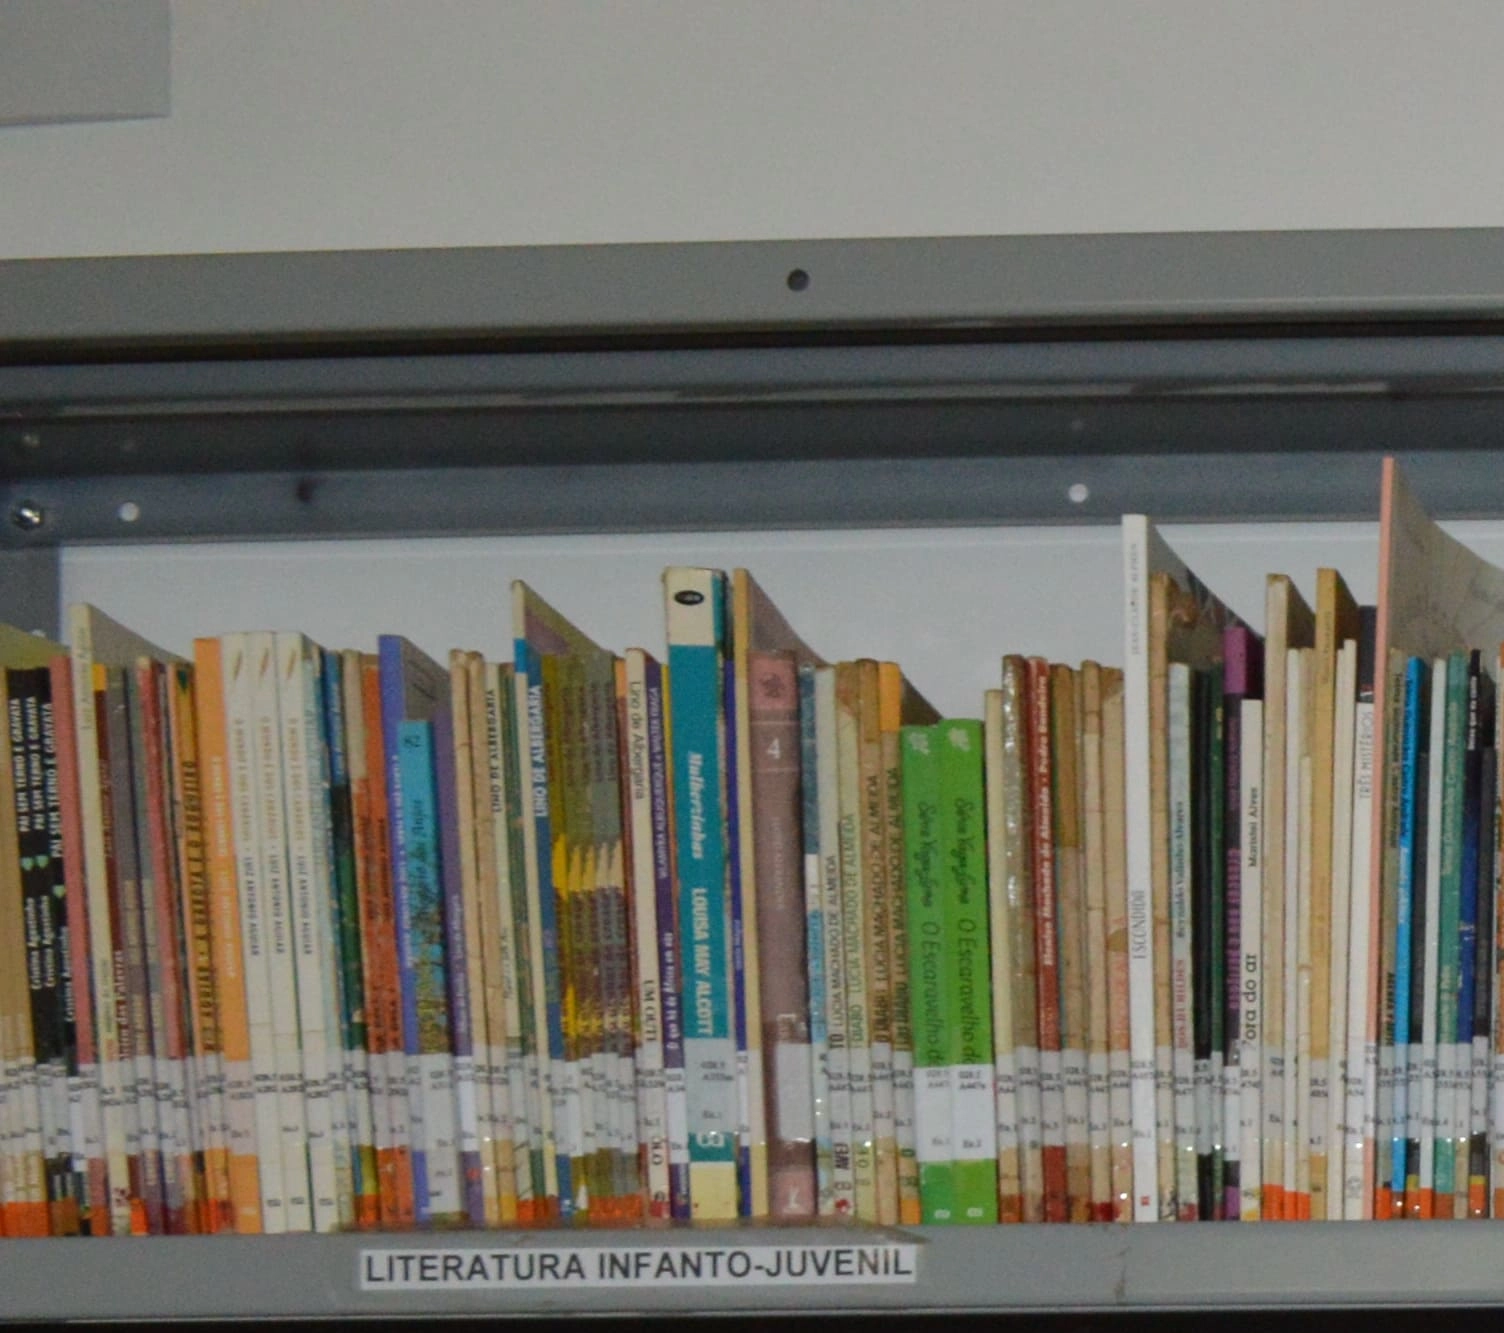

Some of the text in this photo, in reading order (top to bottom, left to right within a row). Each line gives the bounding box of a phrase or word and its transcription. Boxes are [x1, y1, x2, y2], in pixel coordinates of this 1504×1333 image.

[42, 703, 55, 754] GRAVATA
[486, 689, 501, 812] LINO DE ALBERGARIA
[529, 685, 548, 816] LINO DE ALBERGARIA
[47, 769, 58, 808] TERNO
[49, 812, 61, 835] SEM
[51, 839, 62, 857] PAI
[692, 887, 712, 1036] LOUISA MAY ALCOTT
[364, 1249, 912, 1283] LITERATURA INFANTO-JUVENIL
